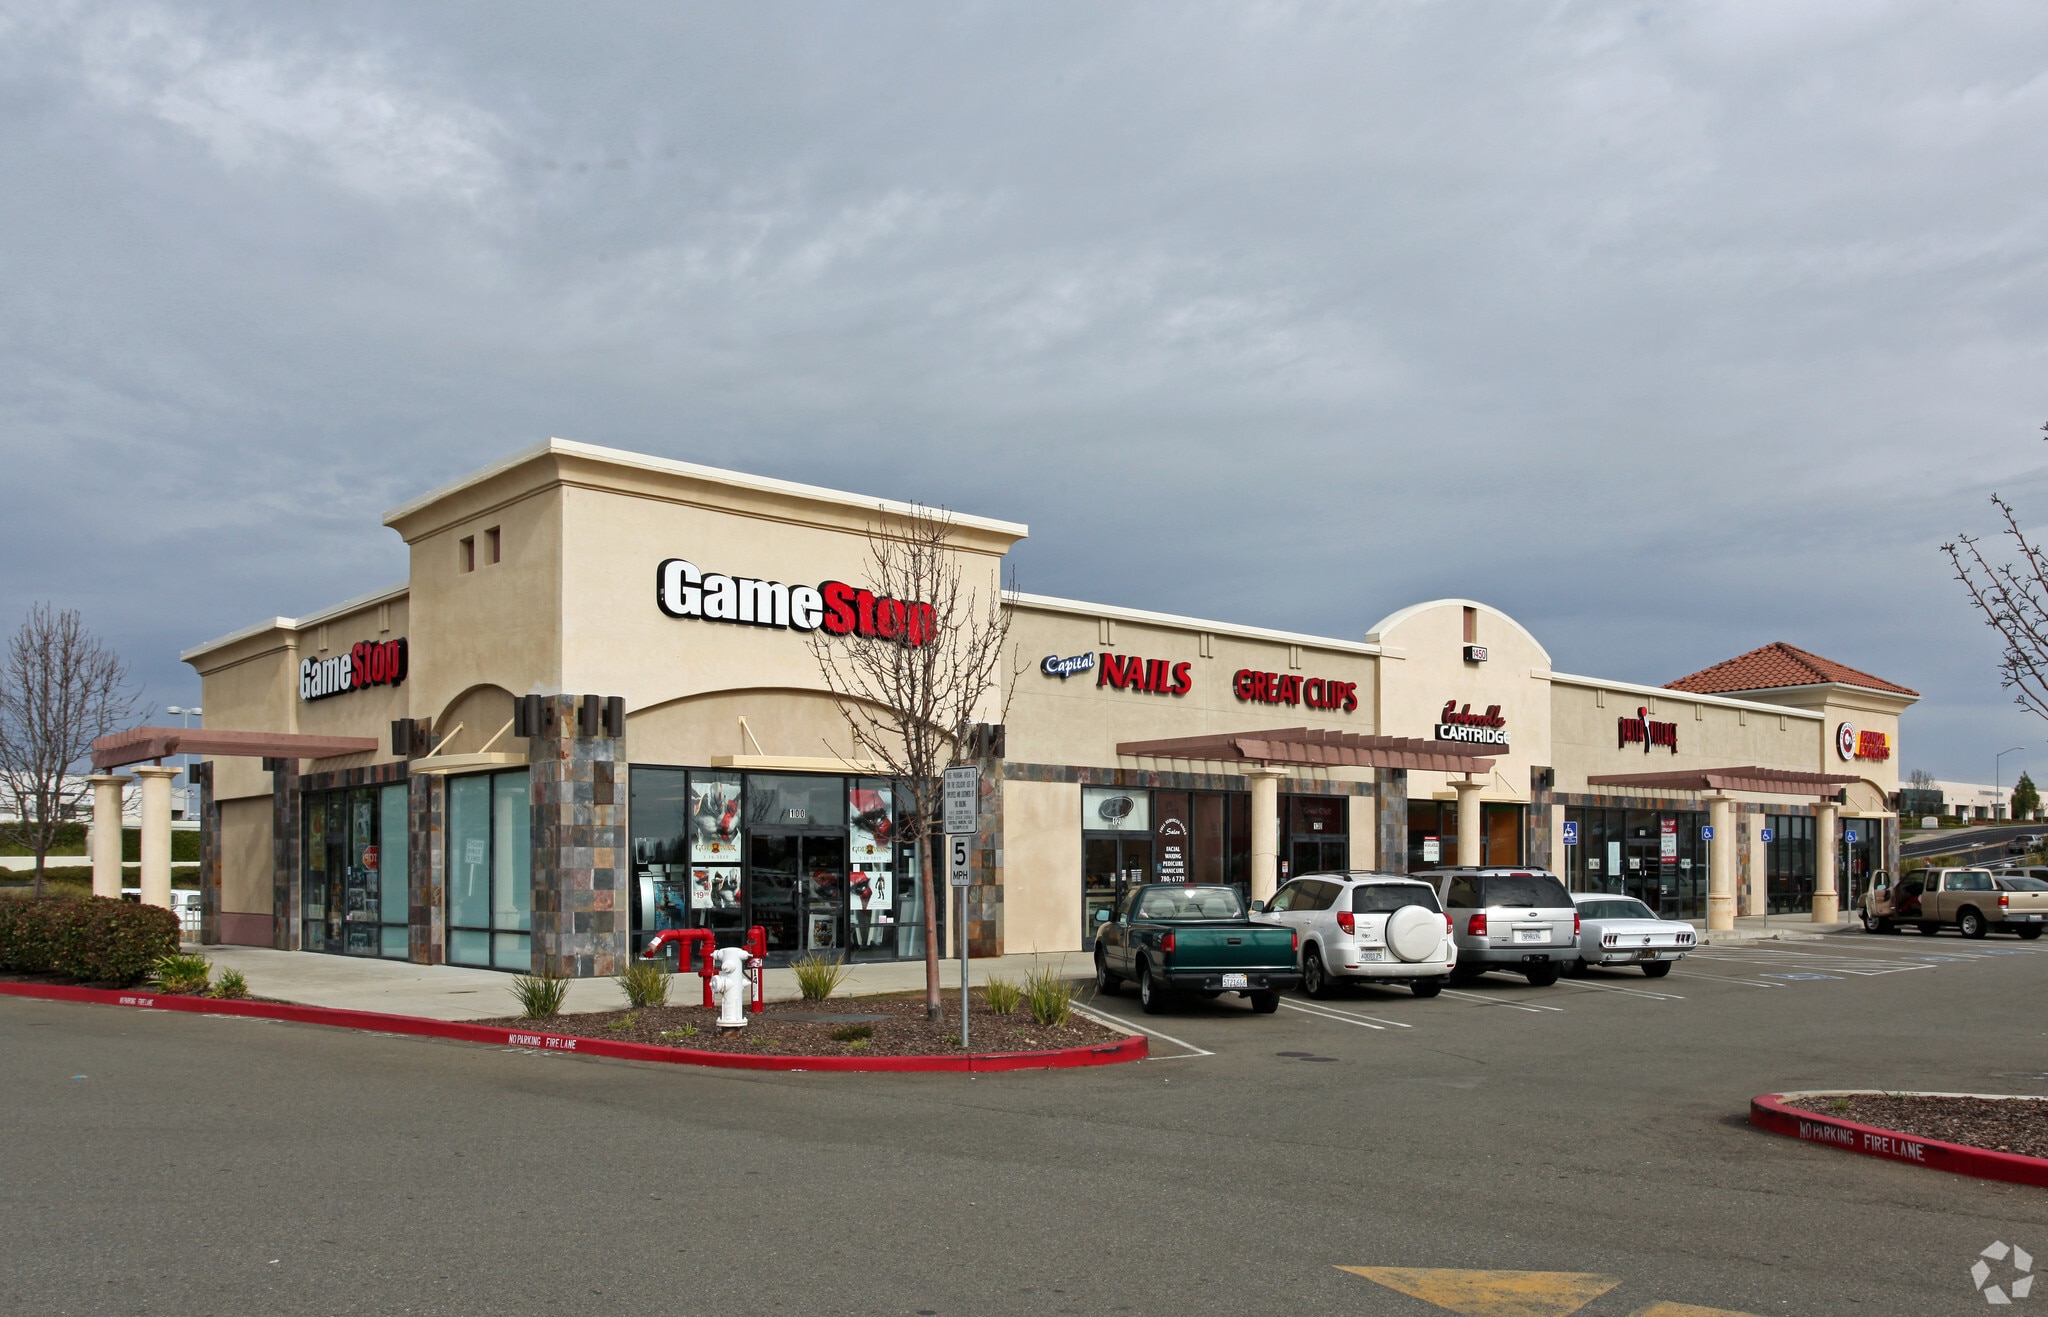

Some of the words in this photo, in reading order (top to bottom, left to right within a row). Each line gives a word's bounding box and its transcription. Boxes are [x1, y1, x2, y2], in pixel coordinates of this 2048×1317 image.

[663, 559, 937, 647] GameStop
[1472, 649, 1486, 660] 1450
[300, 639, 399, 700] GameStop
[1046, 653, 1094, 677] Capital
[1100, 653, 1192, 694] NAILS
[1236, 668, 1304, 704] GREAT
[1306, 677, 1358, 711] CLIPS
[1860, 730, 1886, 746] PANDA
[1858, 743, 1890, 760] EXPRESS
[789, 808, 806, 819] 100
[955, 842, 966, 866] 5
[953, 870, 968, 880] MPH
[508, 1033, 517, 1044] NO
[517, 1034, 541, 1047] PARKING
[545, 1037, 560, 1048] FIRE
[560, 1039, 577, 1050] LANE
[1800, 1120, 1811, 1139] NO
[1813, 1123, 1854, 1146] PARKING
[1864, 1133, 1890, 1153] FIRE
[1891, 1138, 1925, 1162] LANE
